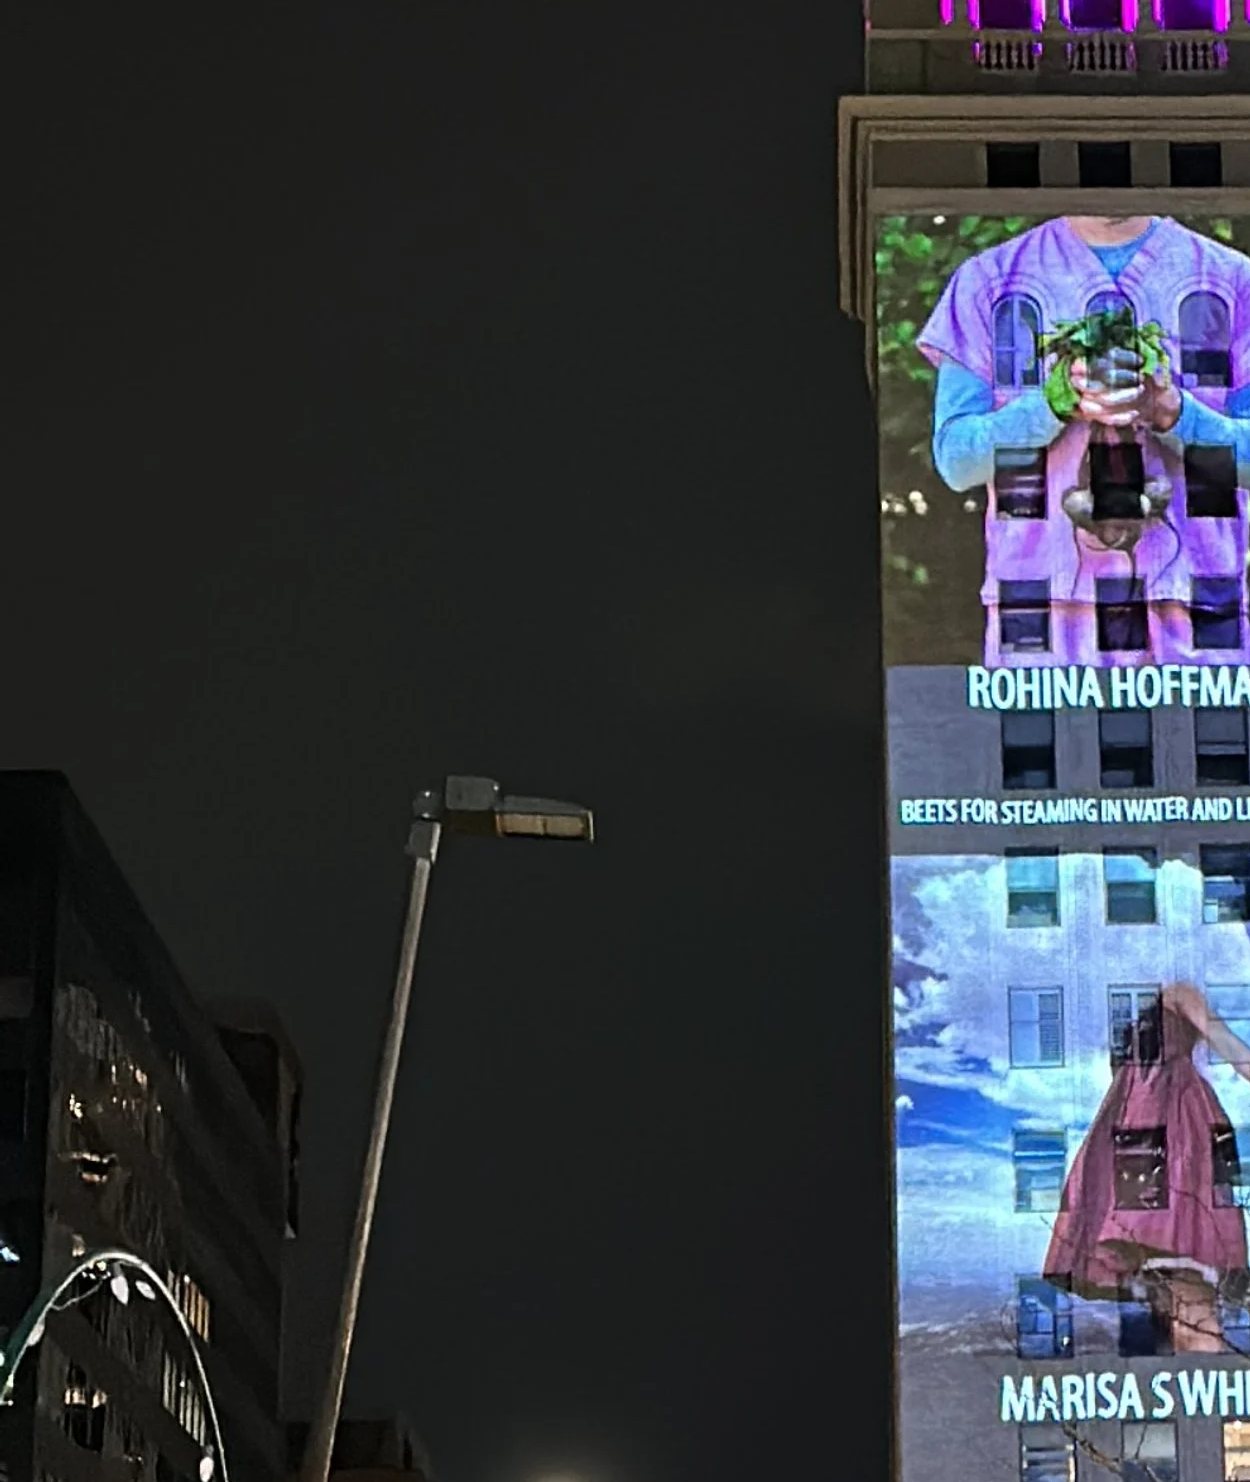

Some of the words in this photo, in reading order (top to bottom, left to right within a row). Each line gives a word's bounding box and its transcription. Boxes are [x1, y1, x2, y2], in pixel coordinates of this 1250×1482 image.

[967, 664, 1104, 710] ROHINA
[901, 798, 958, 825] BEETS
[960, 797, 998, 824] FOR
[1000, 797, 1098, 824] STEAMING
[1101, 798, 1121, 823] IN
[1123, 796, 1189, 822] WATER
[1191, 797, 1232, 821] AND
[1000, 1372, 1145, 1422] MARISA
[1151, 1371, 1175, 1419] S
